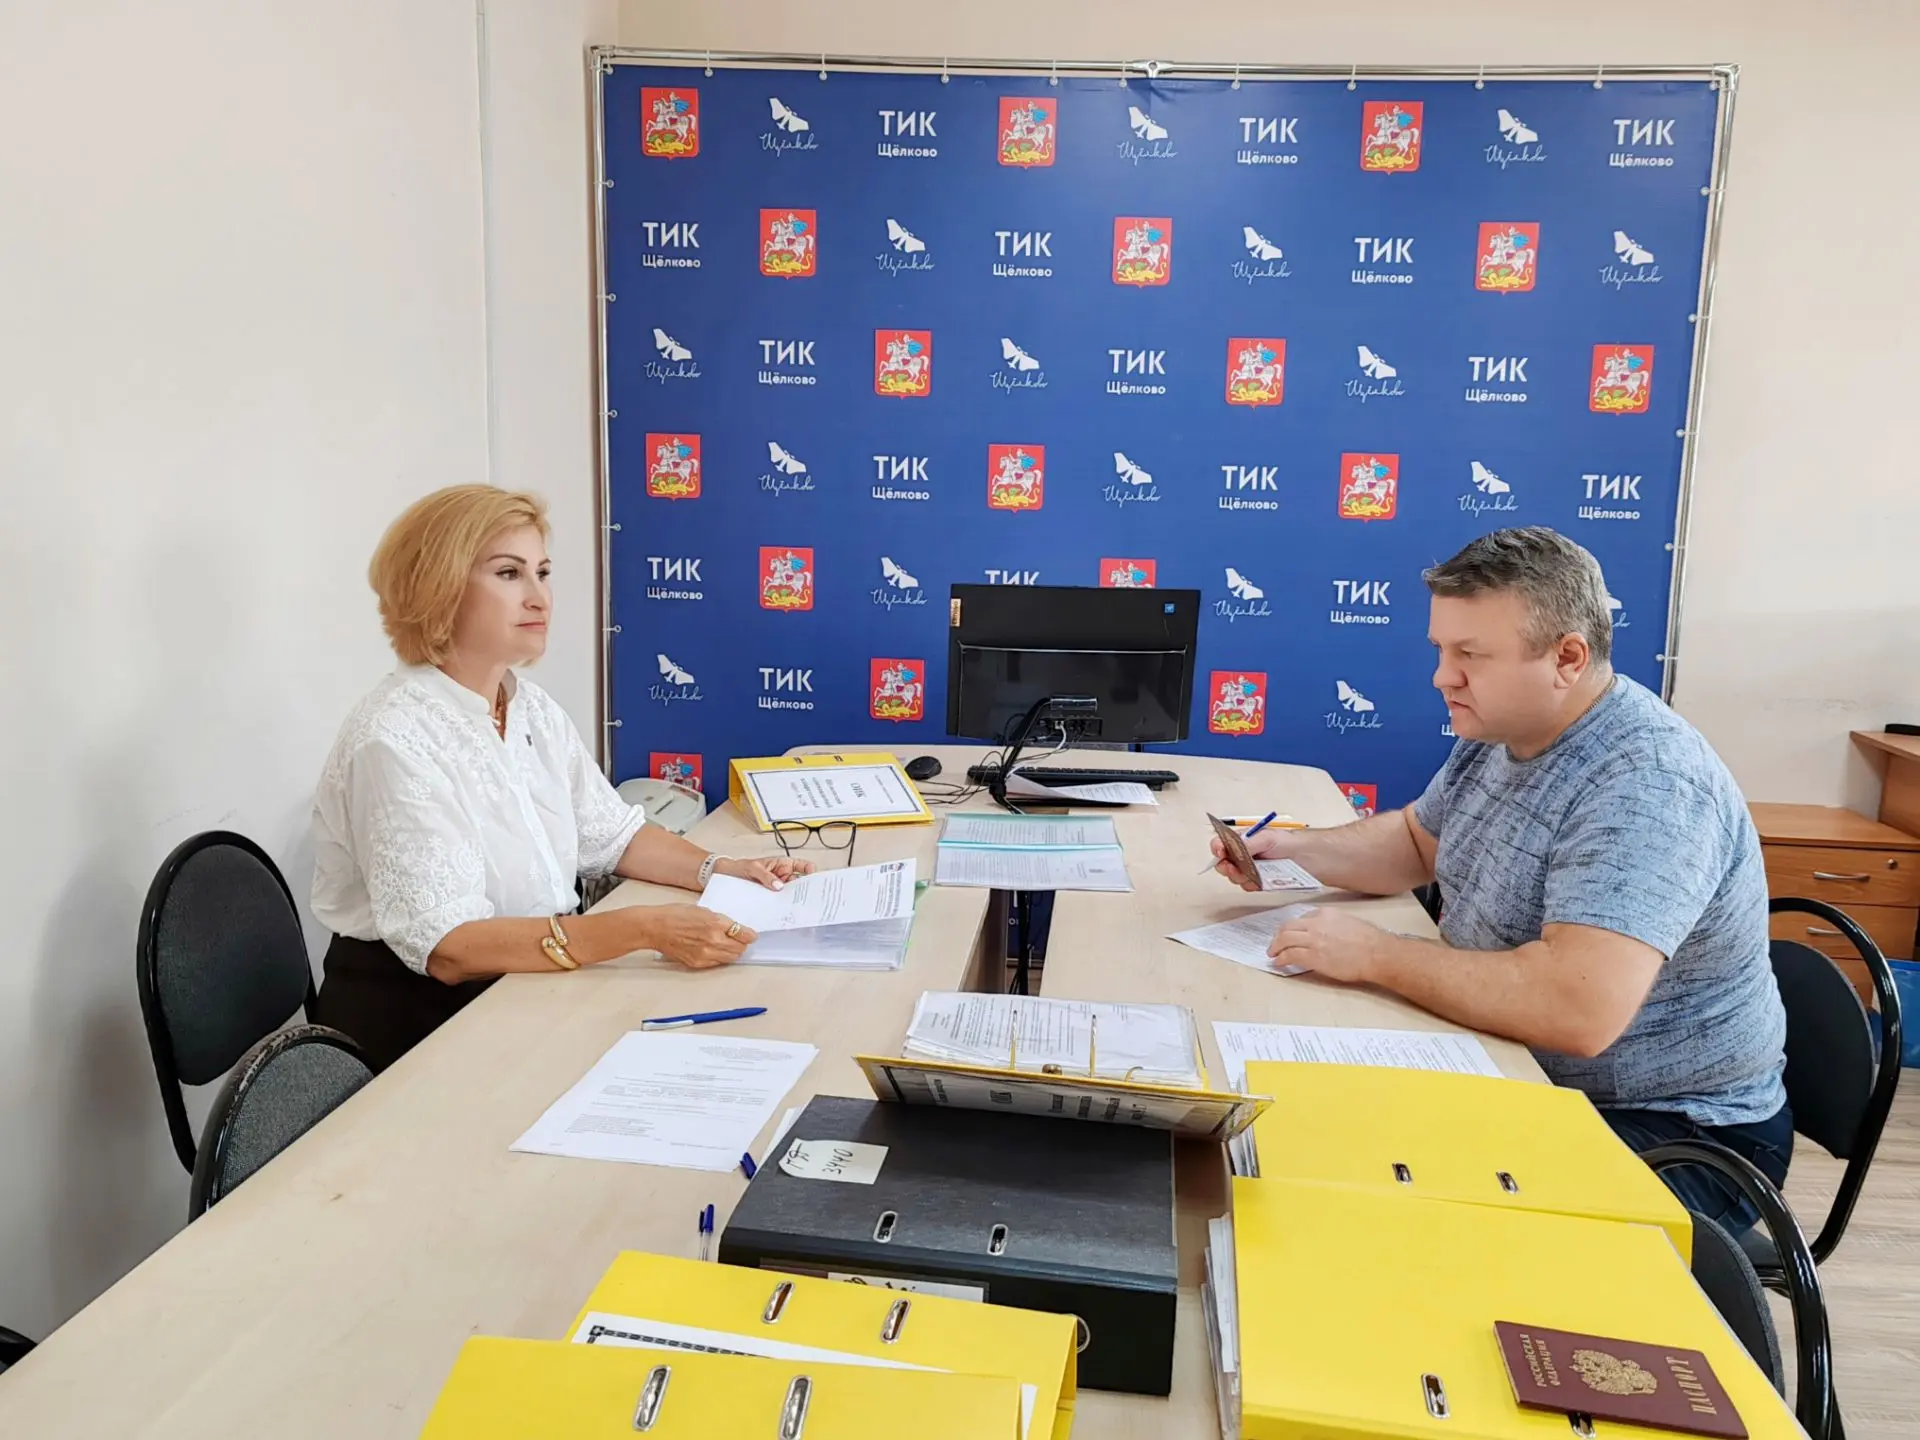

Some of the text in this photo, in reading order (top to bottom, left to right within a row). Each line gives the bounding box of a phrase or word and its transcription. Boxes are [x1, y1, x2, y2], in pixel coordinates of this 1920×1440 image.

[878, 110, 937, 137] ТИК
[1239, 117, 1299, 144] ТИК
[1613, 119, 1676, 146] ТИК
[877, 143, 938, 158] Щёлково
[1237, 150, 1298, 165] Щёлково
[1609, 153, 1674, 168] Щёлково
[642, 222, 700, 249] ТИК
[994, 231, 1052, 257] ТИК
[642, 254, 701, 269] Щёлково
[1354, 237, 1414, 264] ТИК
[992, 263, 1053, 278] Щёлково
[1351, 270, 1414, 285] Щёлково
[758, 339, 816, 366] ТИК
[1108, 349, 1166, 375] ТИК
[758, 370, 817, 385] Щёлково
[1468, 356, 1529, 383] ТИК
[1106, 381, 1166, 395] Щёлково
[1465, 388, 1528, 403] Щёлково
[873, 455, 929, 481] ТИК
[1221, 465, 1279, 491] ТИК
[872, 486, 930, 500] Щёлково
[1581, 474, 1642, 500] ТИК
[1219, 496, 1279, 511] Щёлково
[1578, 506, 1641, 520] Щёлково
[647, 557, 702, 582] ТИК
[984, 569, 1041, 586] ТИК
[647, 586, 704, 600] Щёлково
[1332, 580, 1391, 606] ТИК
[1330, 610, 1390, 625] Щёлково
[758, 667, 813, 692] ТИК
[758, 696, 814, 710] Щёлково
[1519, 1333, 1547, 1388] РОССИЙСКАЯ
[1535, 1339, 1561, 1387] ФЕДЕРАЦИЯ
[1665, 1355, 1718, 1416] ПАСПОРТ
